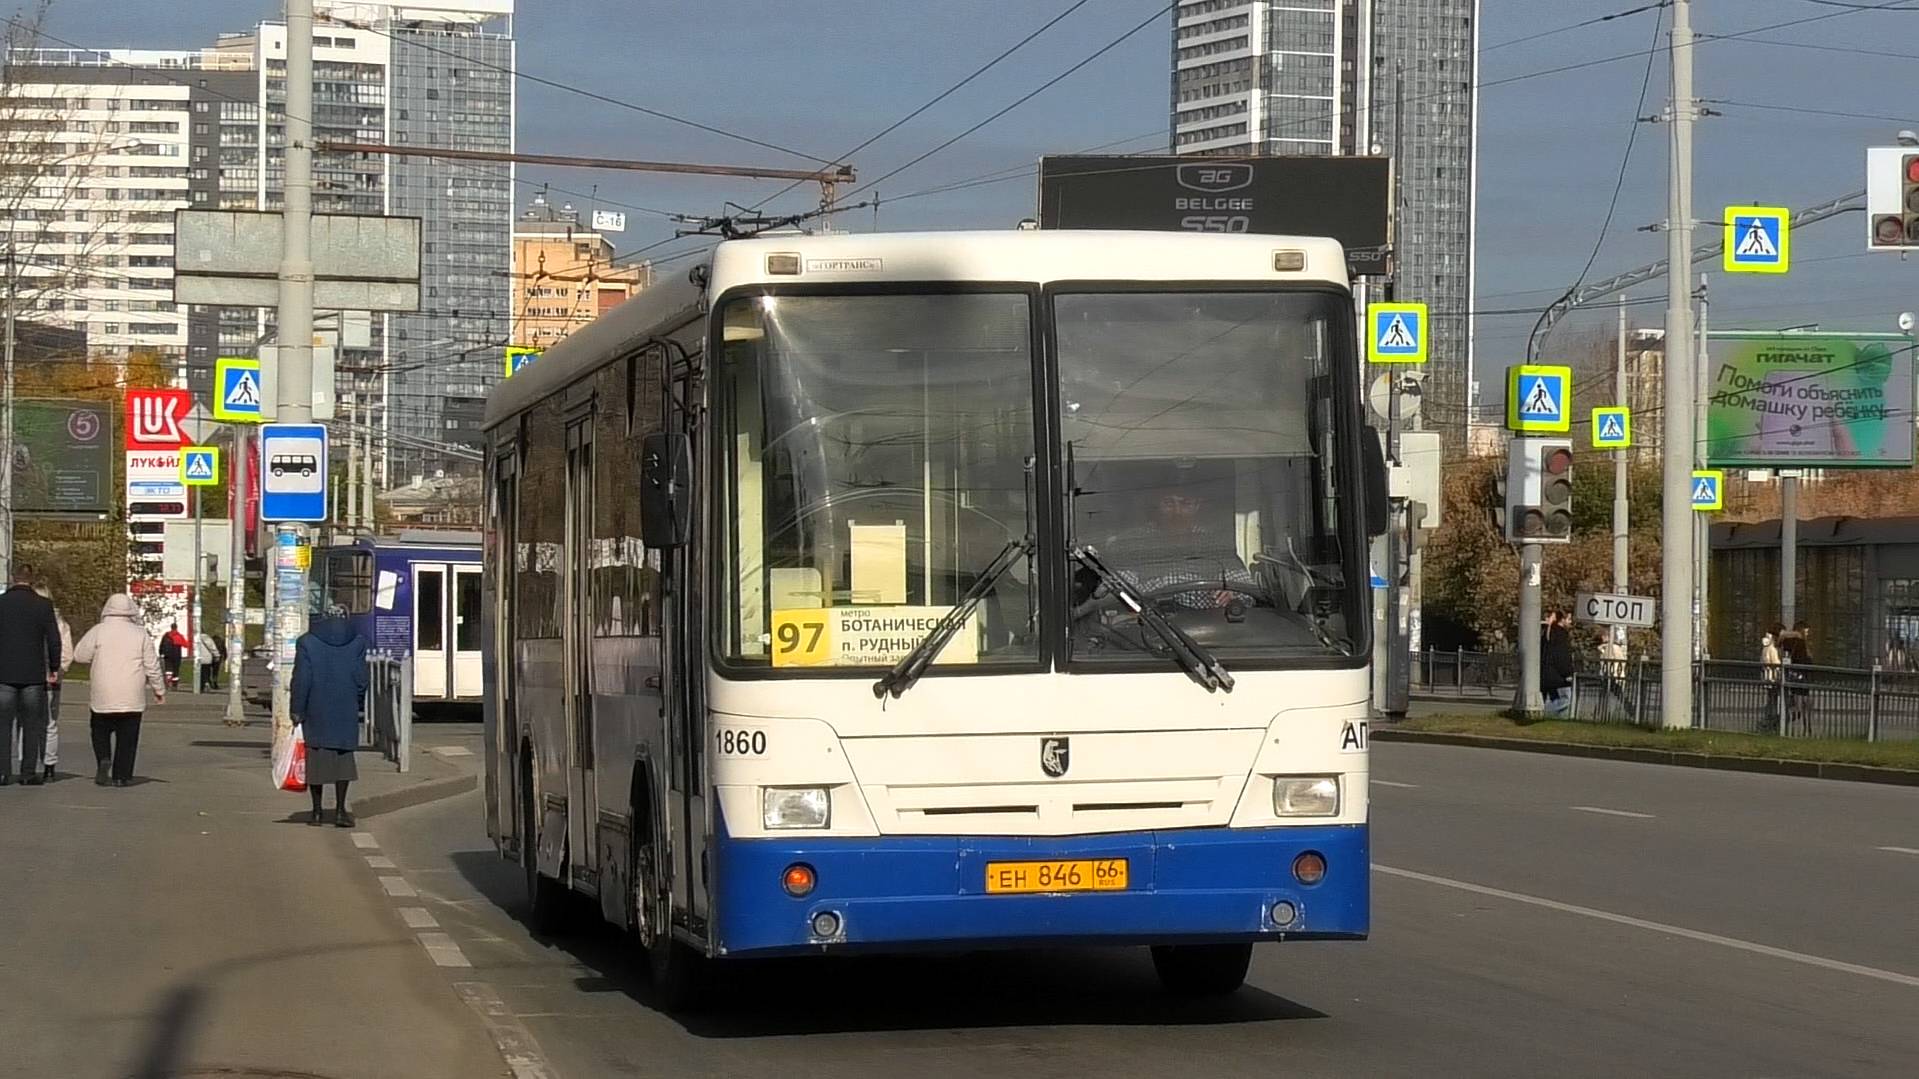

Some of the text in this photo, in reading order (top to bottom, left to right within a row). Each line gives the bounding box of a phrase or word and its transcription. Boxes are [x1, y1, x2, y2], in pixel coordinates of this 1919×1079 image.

[1175, 198, 1253, 210] BELGEE
[1181, 216, 1249, 232] S50
[1716, 363, 1883, 401] Помоги объяснить
[841, 610, 871, 618] метро
[1587, 598, 1643, 621] СТОП
[777, 623, 825, 653] 97
[842, 642, 856, 651] п.
[715, 730, 767, 755] 1860
[1038, 863, 1081, 887] 846
[1096, 861, 1119, 879] 66
